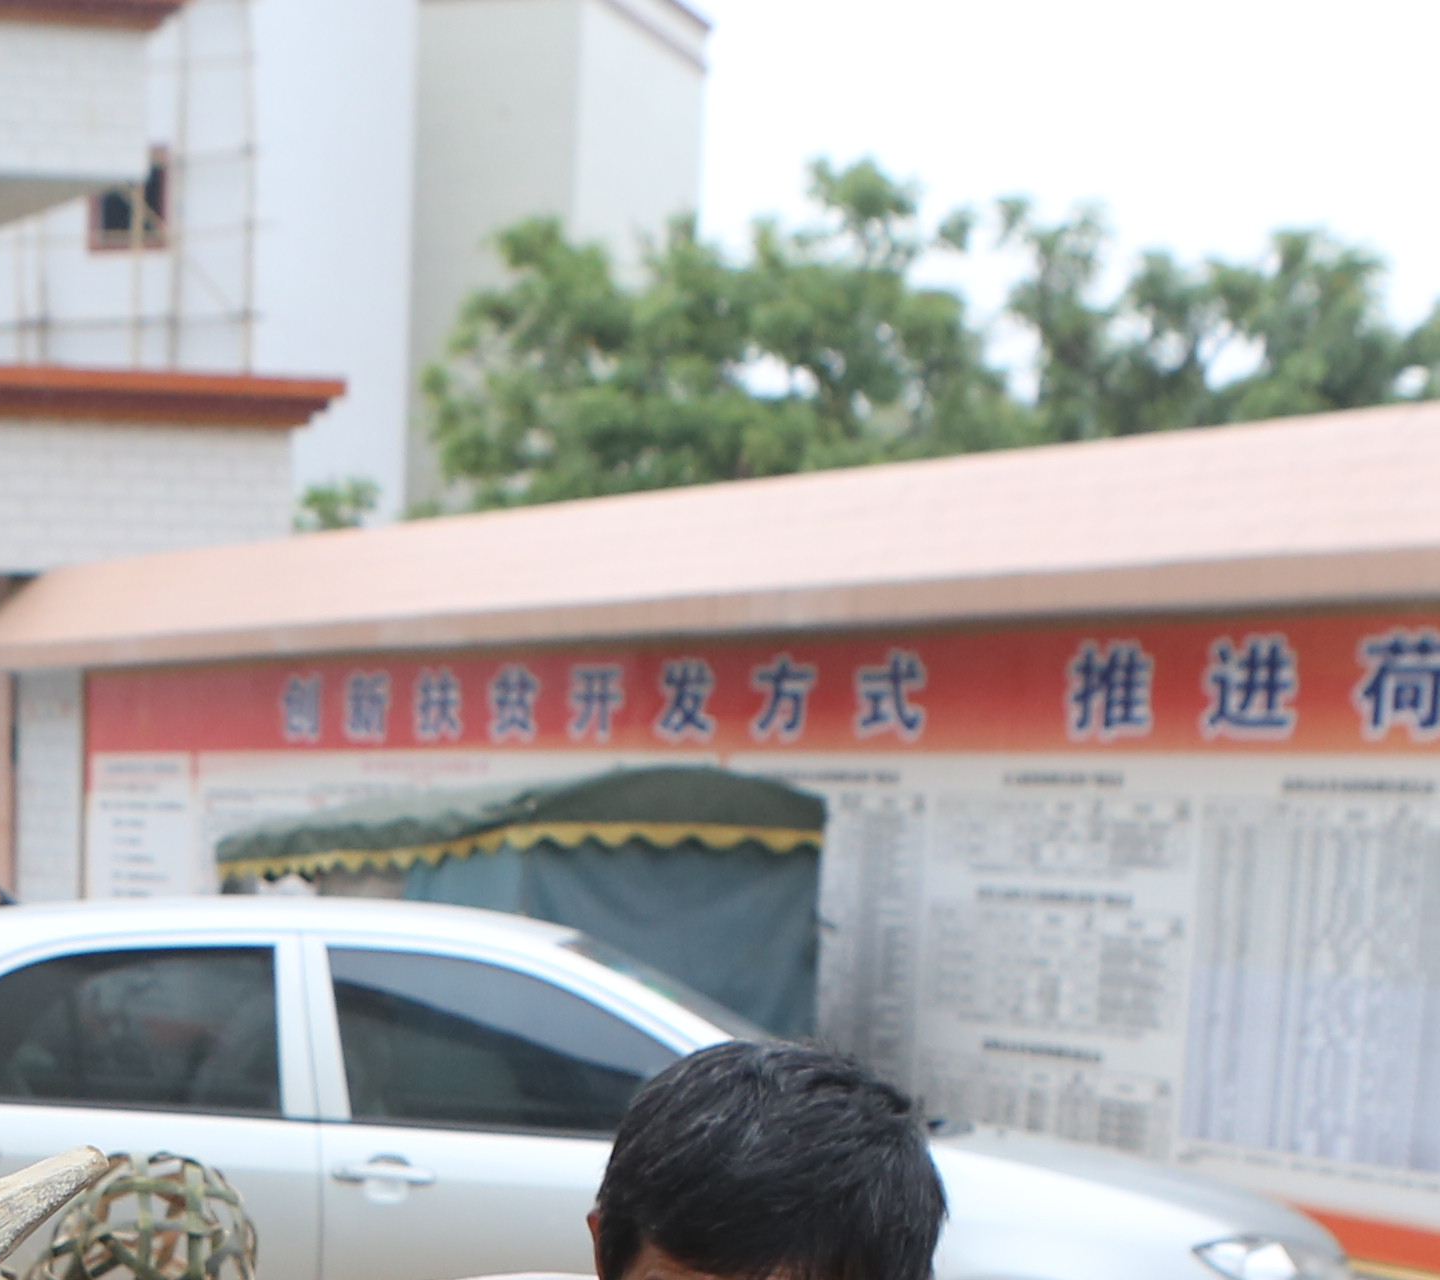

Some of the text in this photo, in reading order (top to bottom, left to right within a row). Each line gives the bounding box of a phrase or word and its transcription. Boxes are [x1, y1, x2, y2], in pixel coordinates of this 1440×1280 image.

[280, 648, 926, 740] 创新扶贫开发方式
